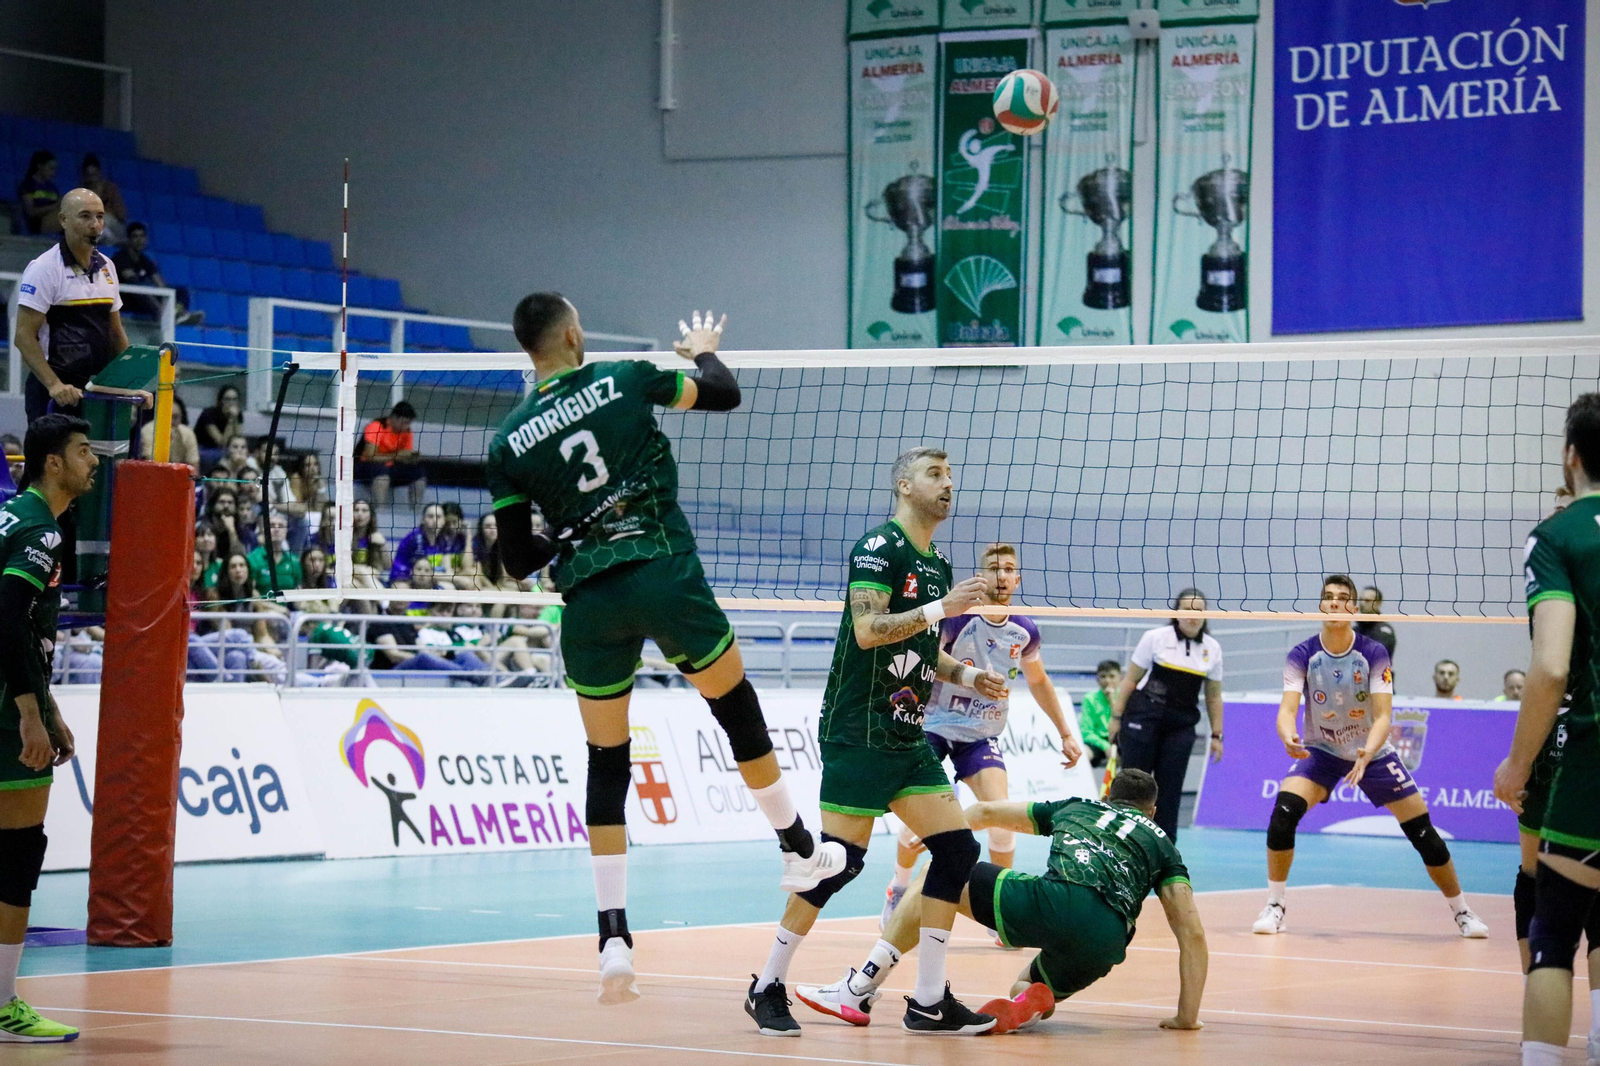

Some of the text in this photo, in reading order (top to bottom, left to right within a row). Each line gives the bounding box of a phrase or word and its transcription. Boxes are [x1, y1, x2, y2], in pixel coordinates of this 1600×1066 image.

[1061, 33, 1120, 49] UNICAJA
[1175, 33, 1237, 49] UNICAJA
[1289, 17, 1569, 84] DIPUTACIÓN
[1294, 65, 1562, 131] DE ALMERÍA
[507, 376, 623, 458] RODRÍGUEZ
[559, 429, 610, 493] 3
[854, 555, 889, 568] Fundación
[856, 561, 883, 572] Unicaja
[438, 754, 569, 786] COSTA DE
[1386, 761, 1406, 783] 5
[706, 784, 760, 813] CIUD
[430, 790, 588, 846] ALMERÍA
[1096, 810, 1137, 840] 11
